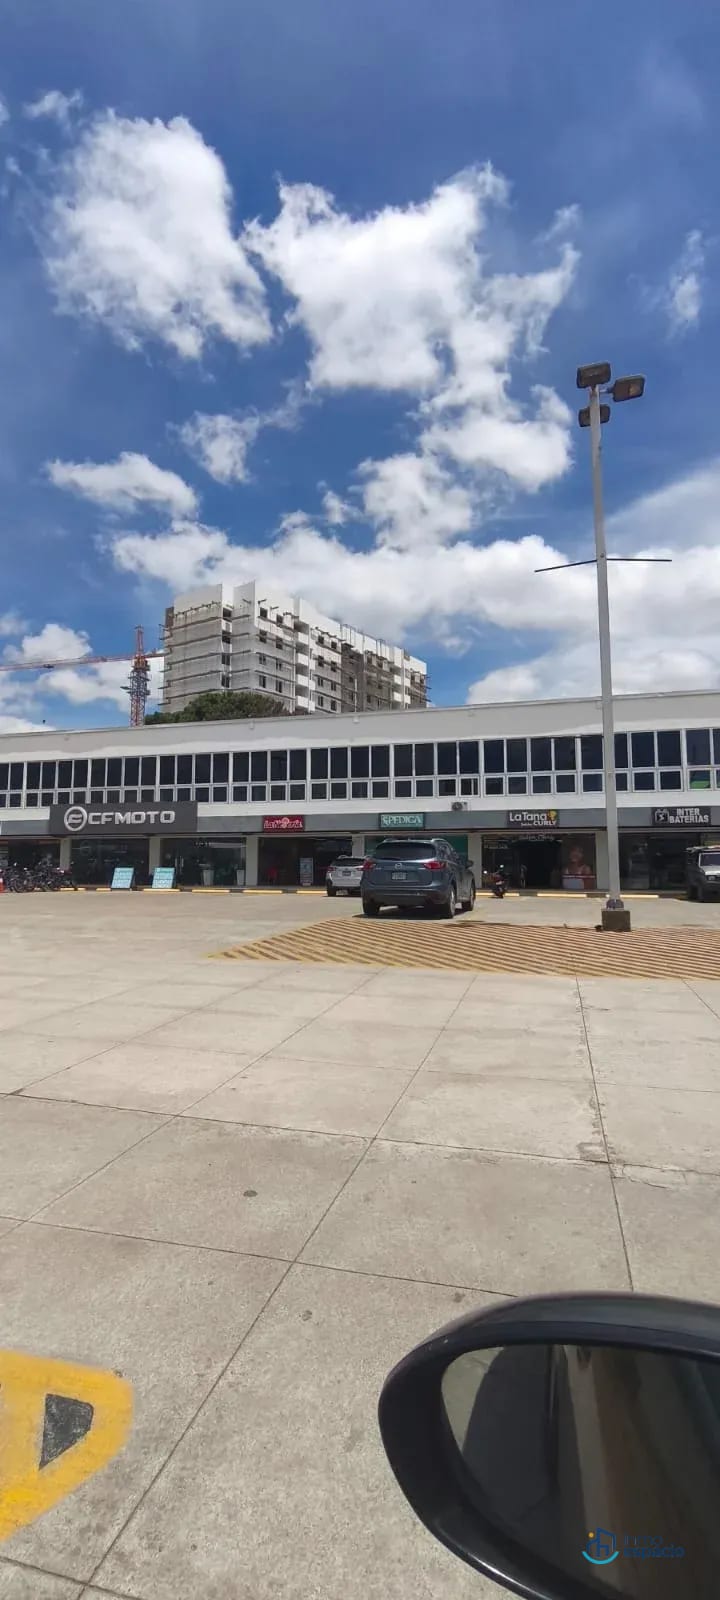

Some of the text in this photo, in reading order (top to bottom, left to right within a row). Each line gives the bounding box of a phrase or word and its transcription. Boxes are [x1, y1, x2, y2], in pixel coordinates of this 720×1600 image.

[676, 808, 700, 816] INTER
[87, 811, 176, 825] CFMOTO
[669, 815, 709, 824] BATERIAS
